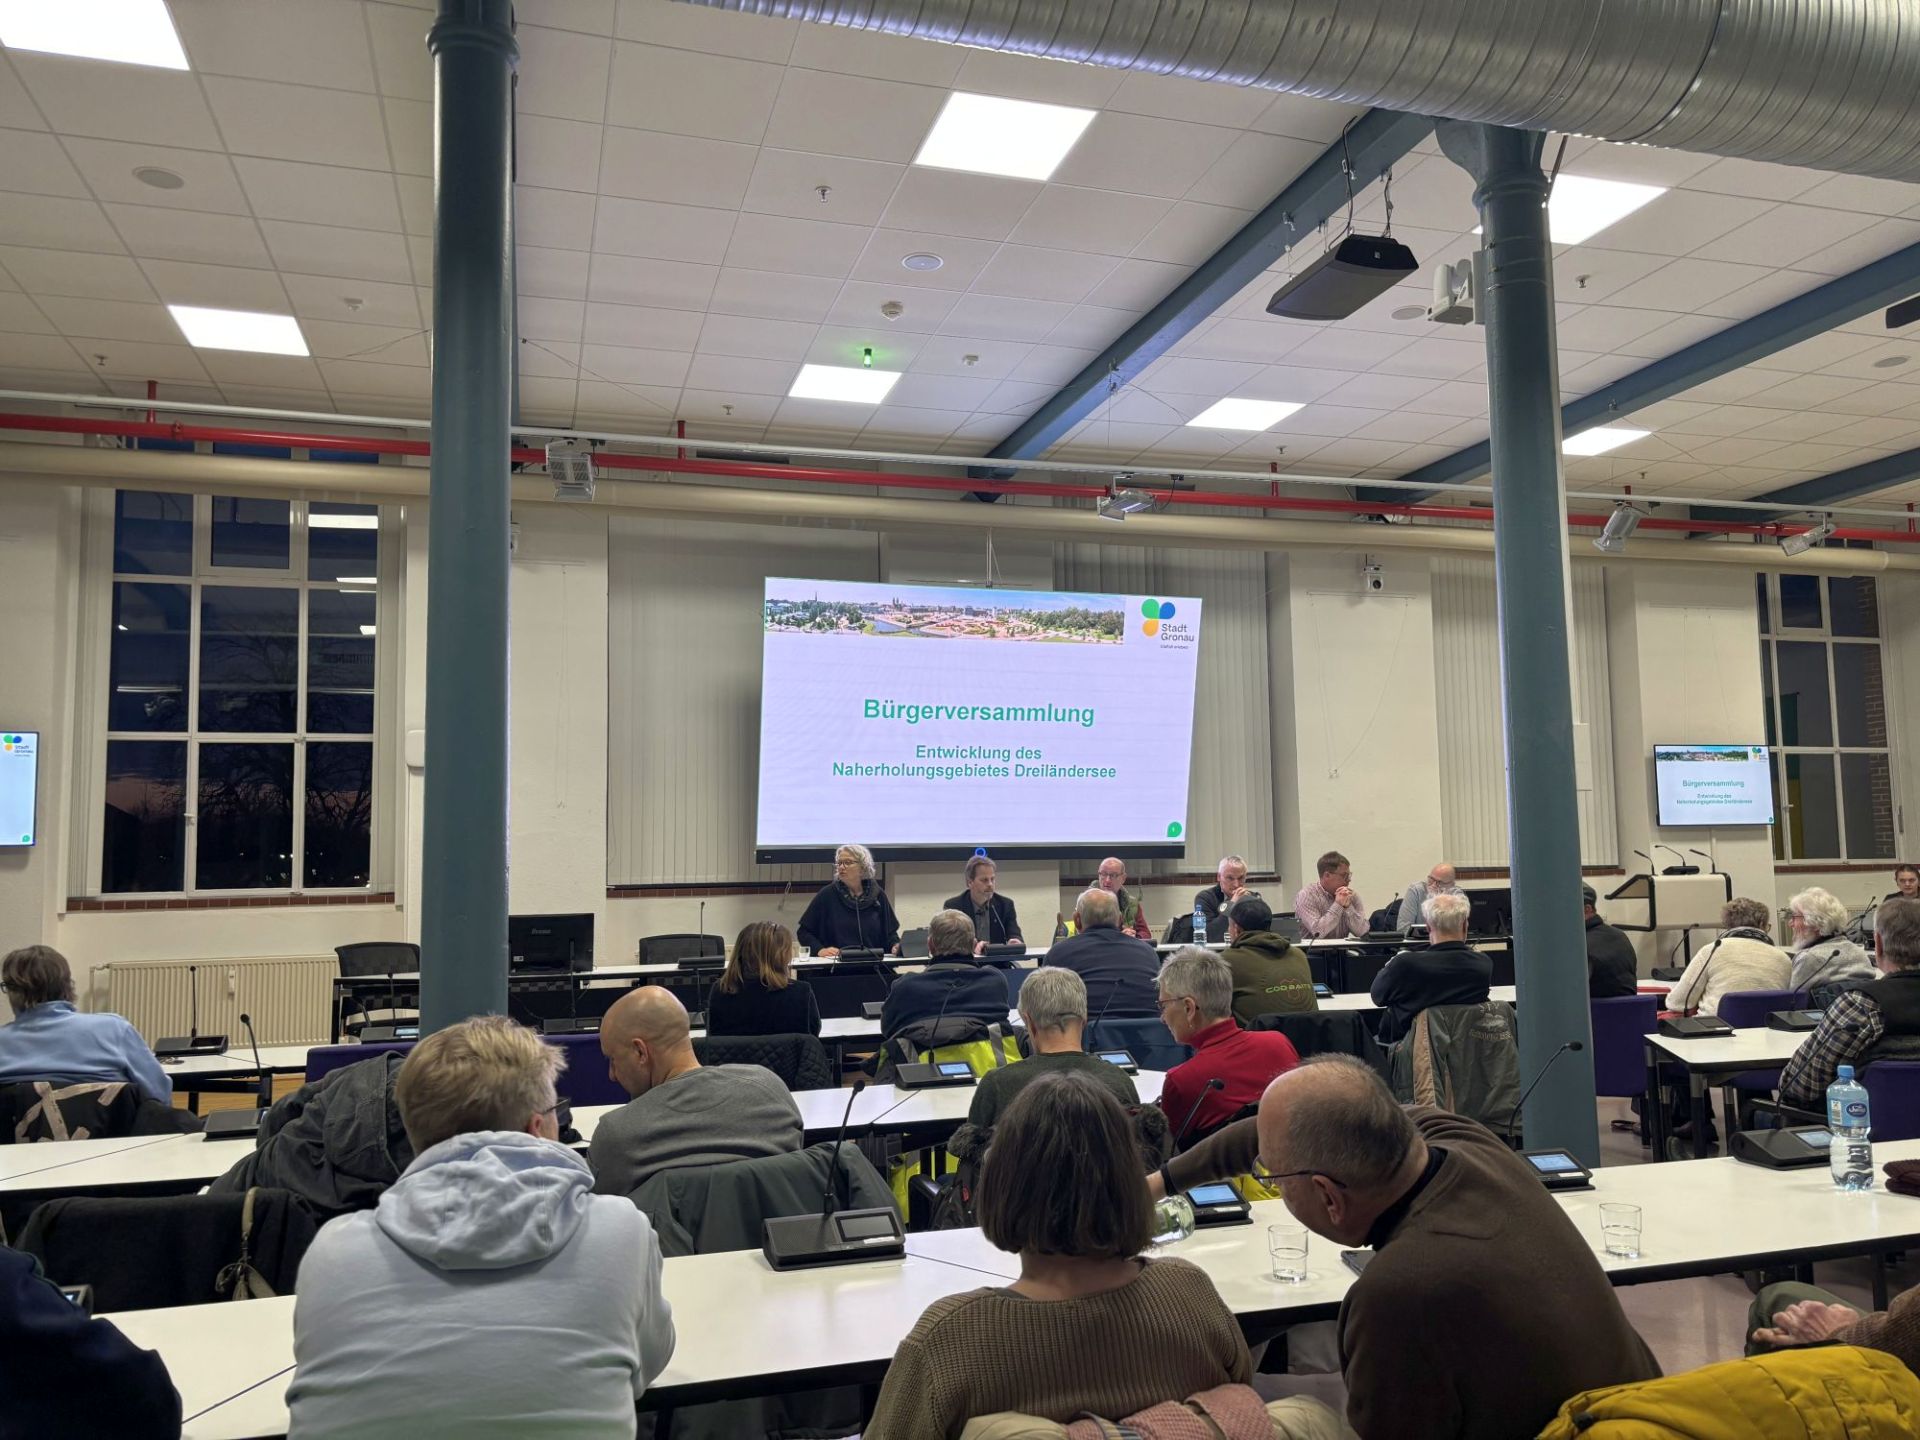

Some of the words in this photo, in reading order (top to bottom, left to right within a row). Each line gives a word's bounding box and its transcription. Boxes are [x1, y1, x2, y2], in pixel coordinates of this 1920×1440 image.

[1161, 623, 1187, 633] Stadt
[1160, 632, 1195, 642] Gronau
[863, 698, 1095, 727] Bürgerversammlung
[915, 744, 1011, 763] Entwicklung
[1015, 746, 1042, 760] des
[832, 761, 1010, 780] Naherholungsgebietes
[1014, 762, 1117, 779] Dreiländersee
[1682, 780, 1744, 788] Bürgerversammlung
